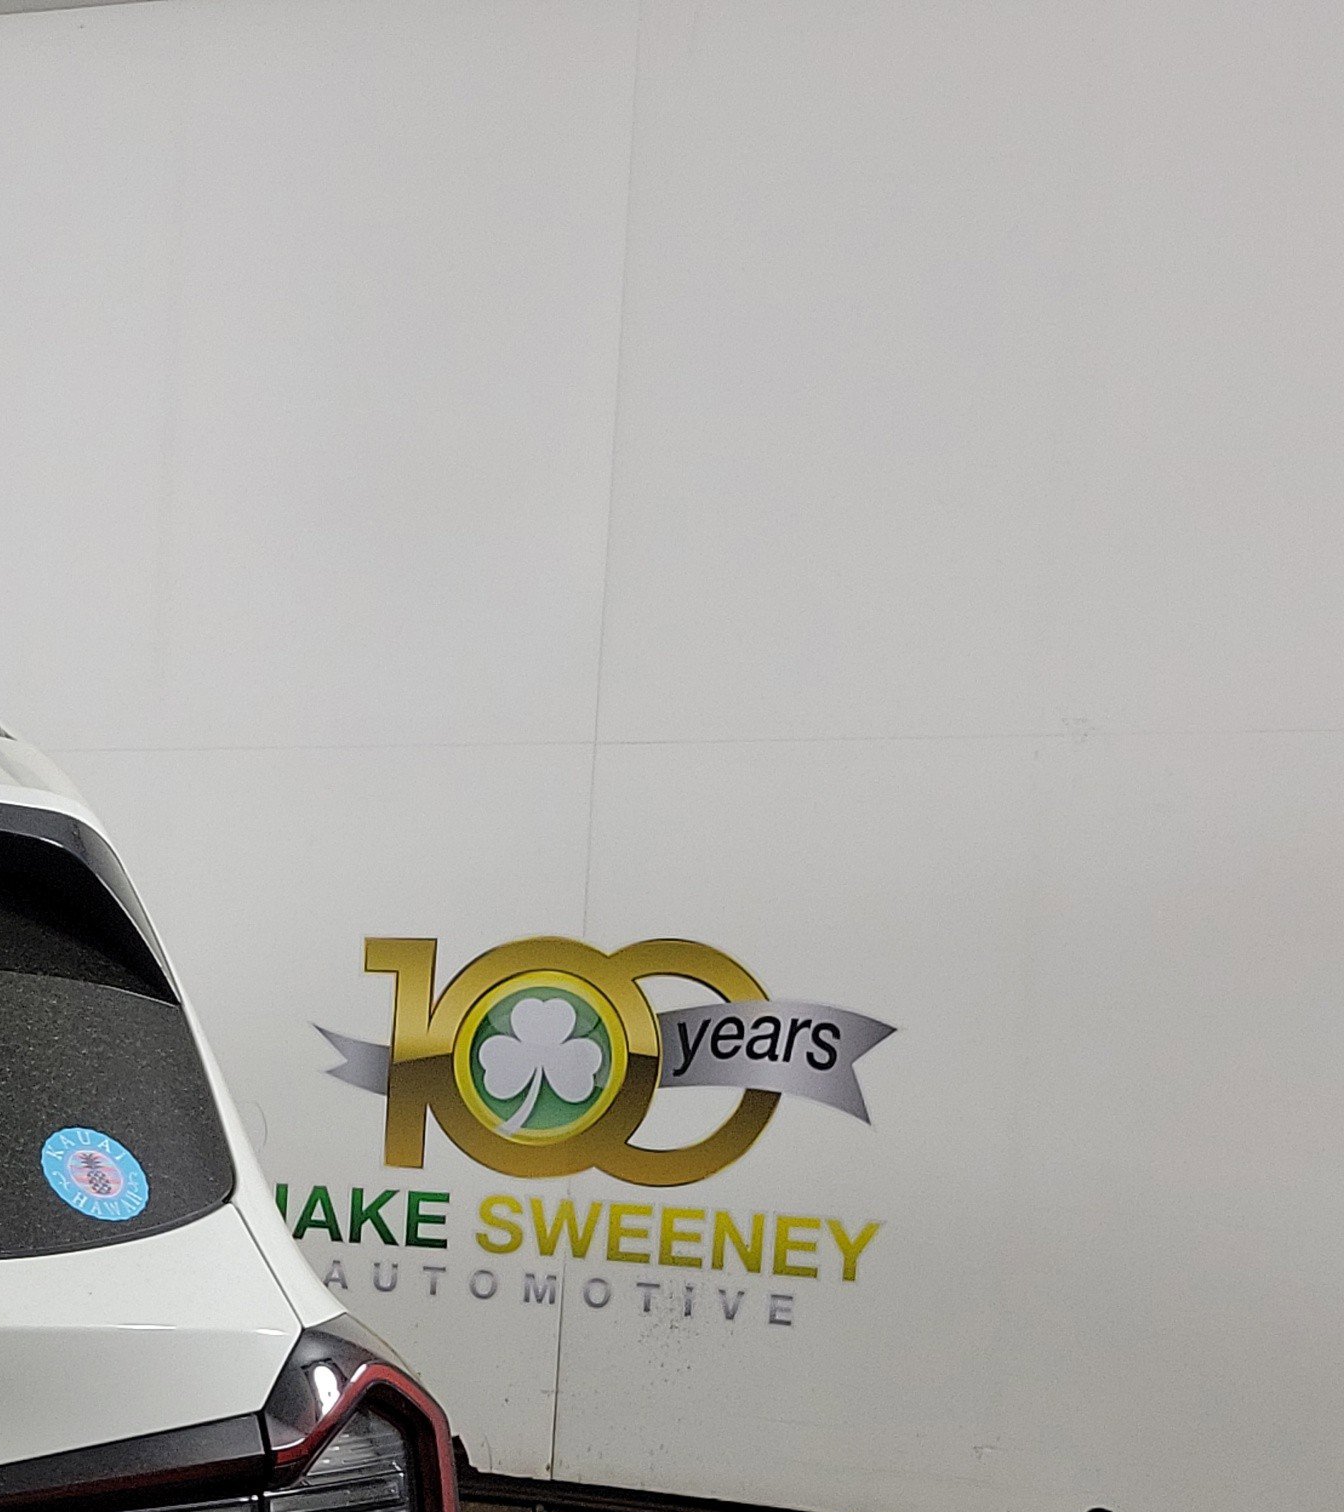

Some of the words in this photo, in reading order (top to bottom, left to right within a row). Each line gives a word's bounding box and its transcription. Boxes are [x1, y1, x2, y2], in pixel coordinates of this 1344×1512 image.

[364, 936, 780, 1187] 100
[671, 1013, 841, 1077] years
[45, 1131, 126, 1160] KAUAI
[73, 1190, 143, 1216] HAWAII
[475, 1195, 882, 1282] SWEENEY
[323, 1259, 795, 1326] AUTOMOTIVE
